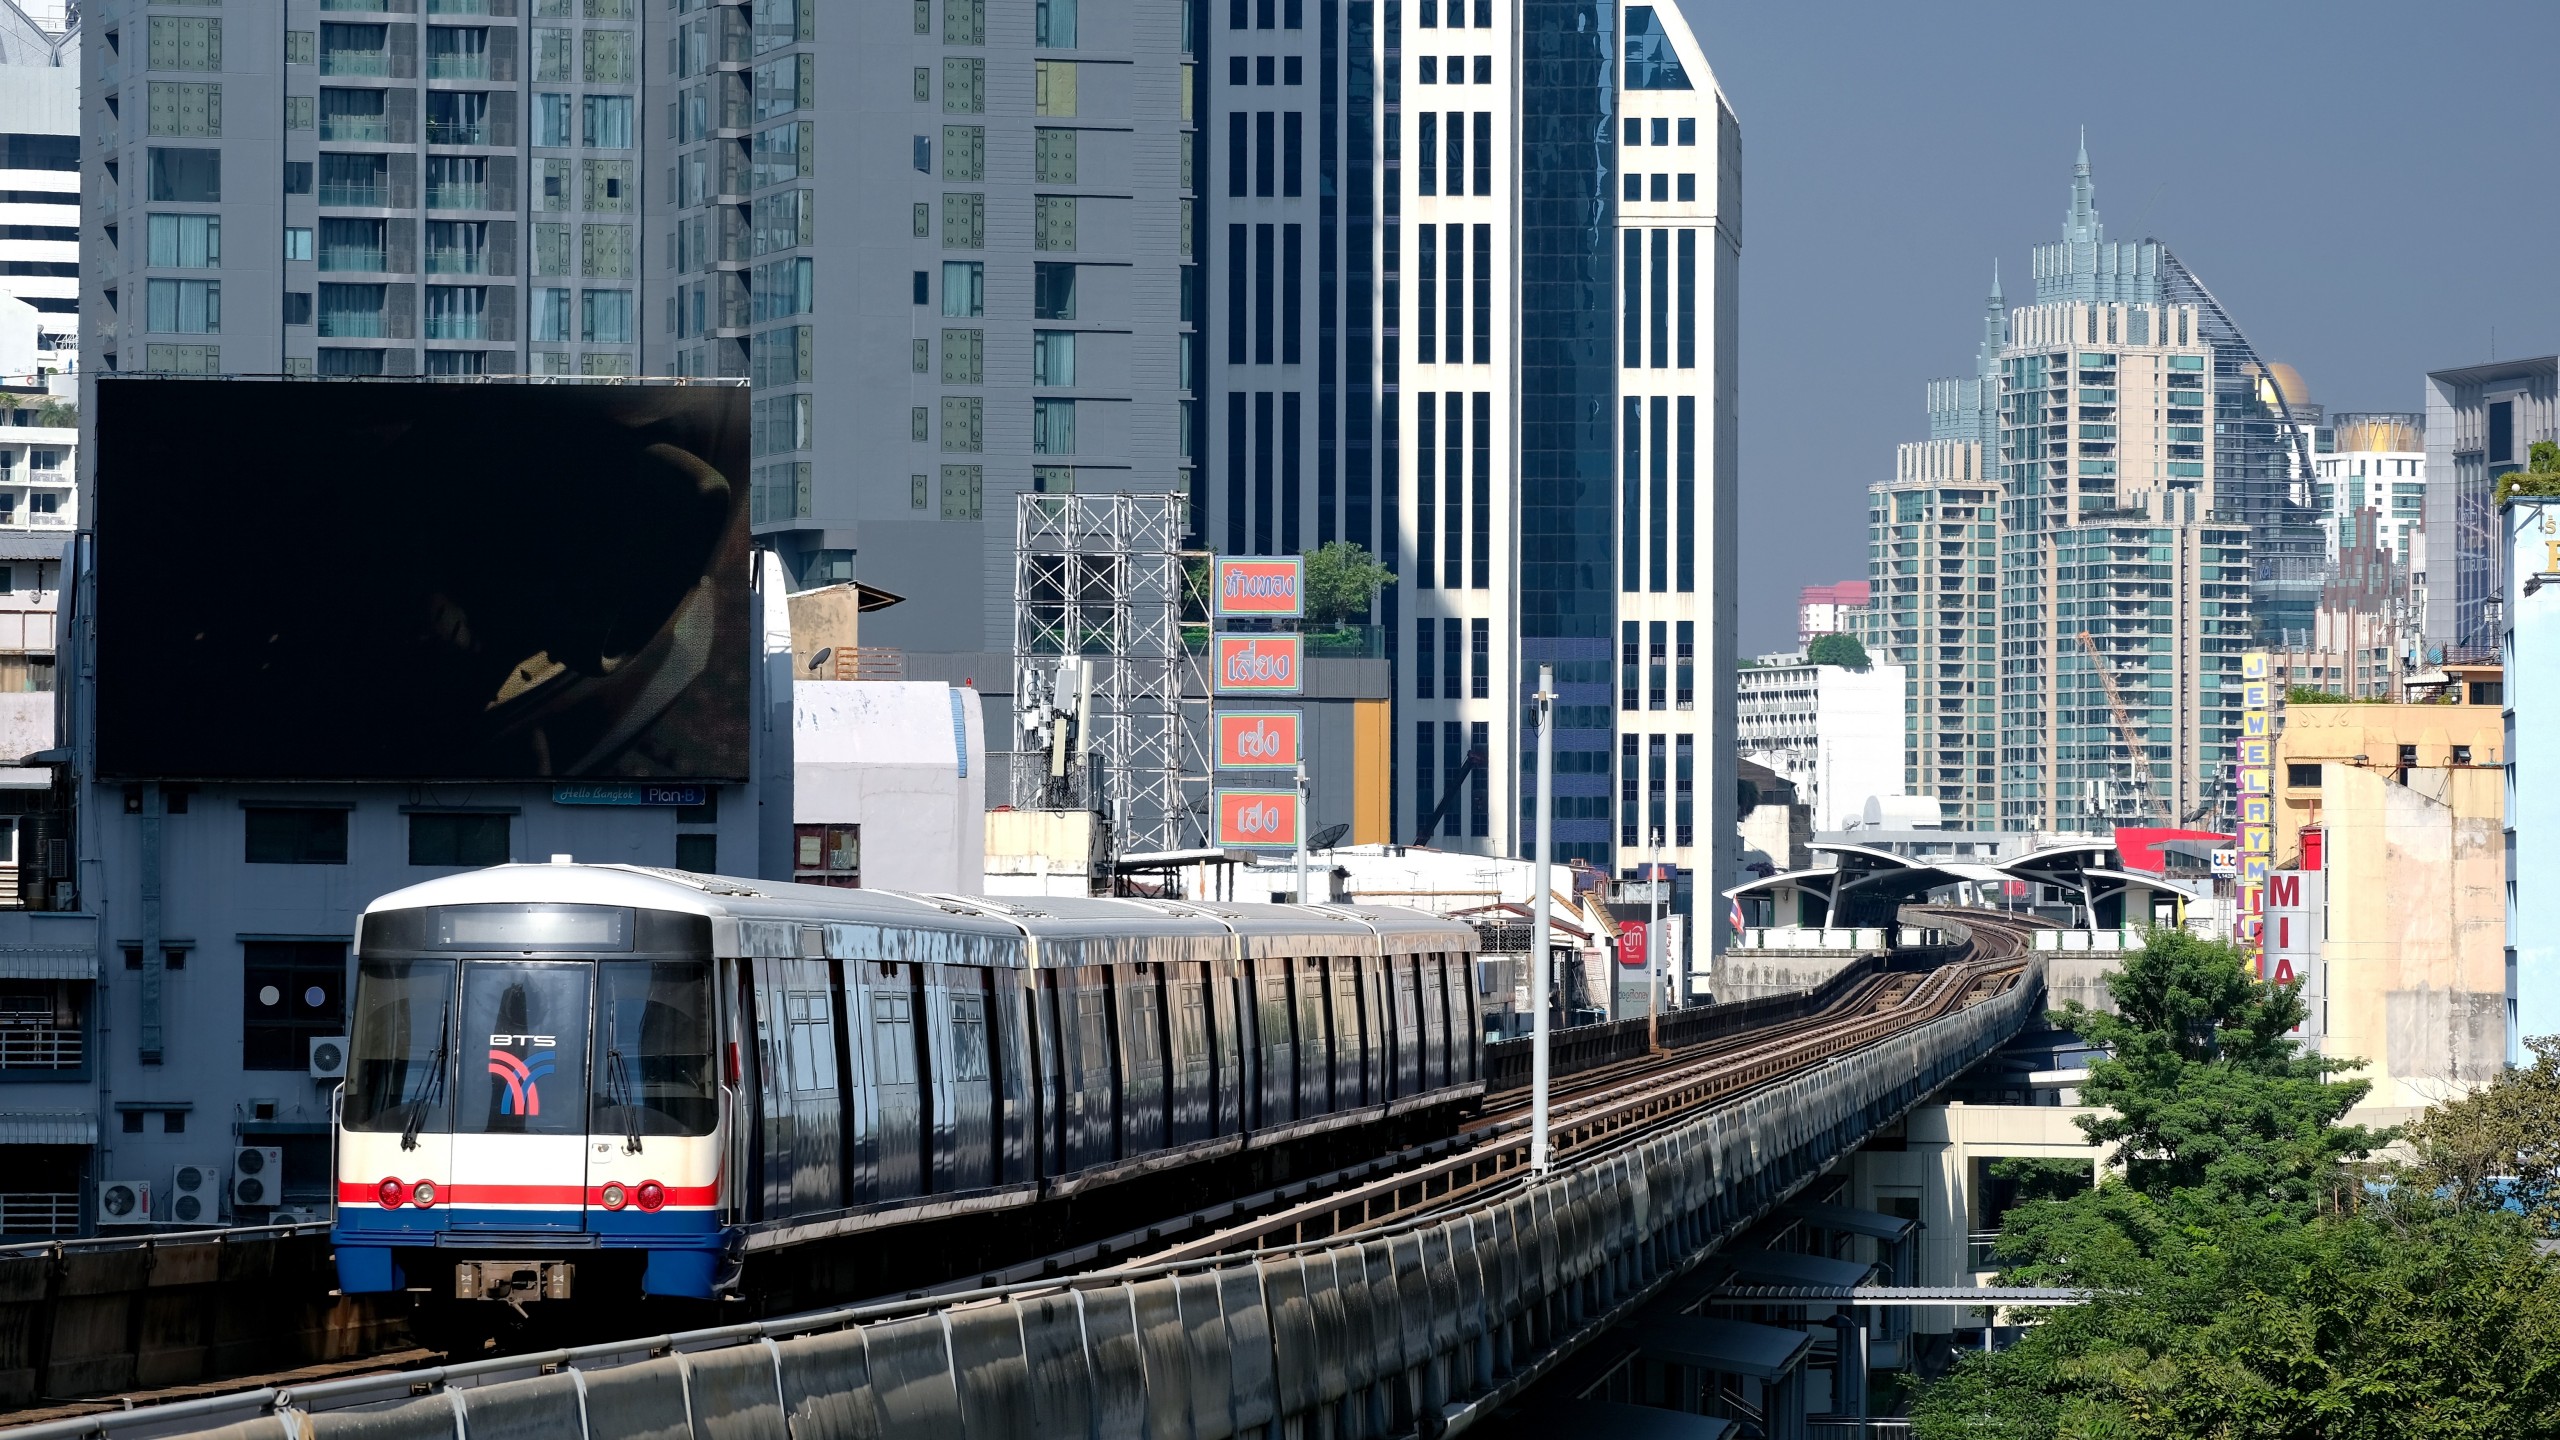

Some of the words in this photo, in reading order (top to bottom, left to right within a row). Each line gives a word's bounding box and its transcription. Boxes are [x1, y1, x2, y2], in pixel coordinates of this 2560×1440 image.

[1224, 568, 1296, 598] ห้างทอง
[560, 786, 592, 800] Hello
[593, 786, 634, 802] Bangkok
[1237, 800, 1279, 834] เฮง
[2213, 853, 2236, 866] ttb
[2270, 876, 2299, 984] MIA
[489, 1034, 556, 1047] BTS
